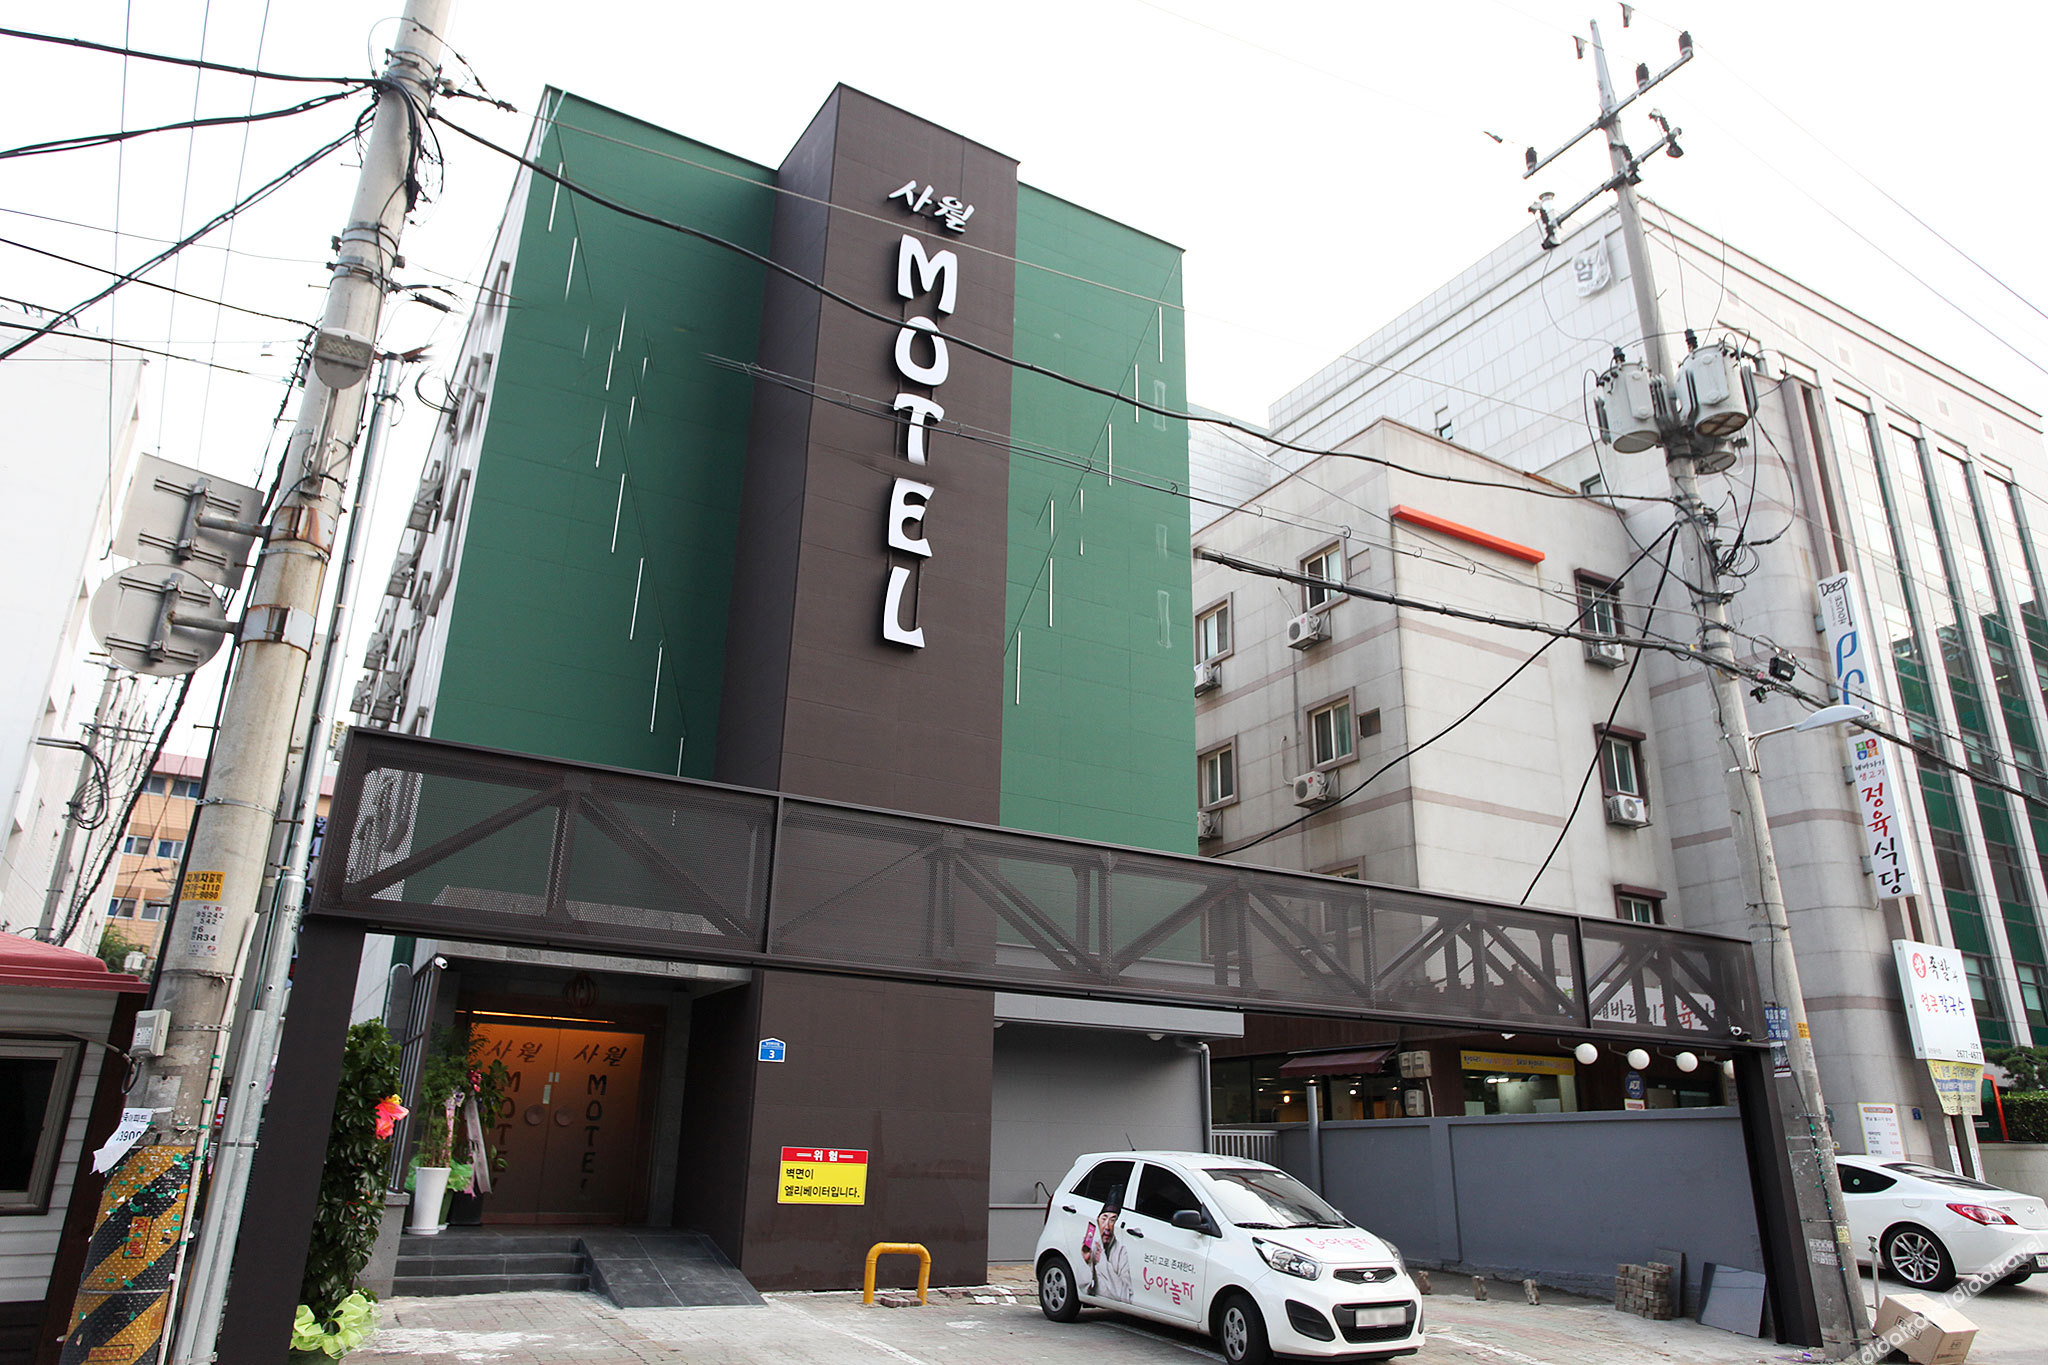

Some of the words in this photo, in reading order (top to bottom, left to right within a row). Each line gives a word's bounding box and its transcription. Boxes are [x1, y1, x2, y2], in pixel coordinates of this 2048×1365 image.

[888, 180, 975, 233] 사월
[882, 234, 958, 649] MOTEL
[1861, 782, 1906, 895] 정육식당
[1929, 956, 1951, 981] 족발
[485, 1040, 543, 1063] 사월
[574, 1043, 627, 1067] 사월
[768, 1050, 775, 1059] 3
[813, 1149, 839, 1162] 위험
[786, 1168, 814, 1180] 벽면이
[784, 1185, 860, 1198] 엘리베이터입니다.
[1156, 1276, 1195, 1305] 야놀자
